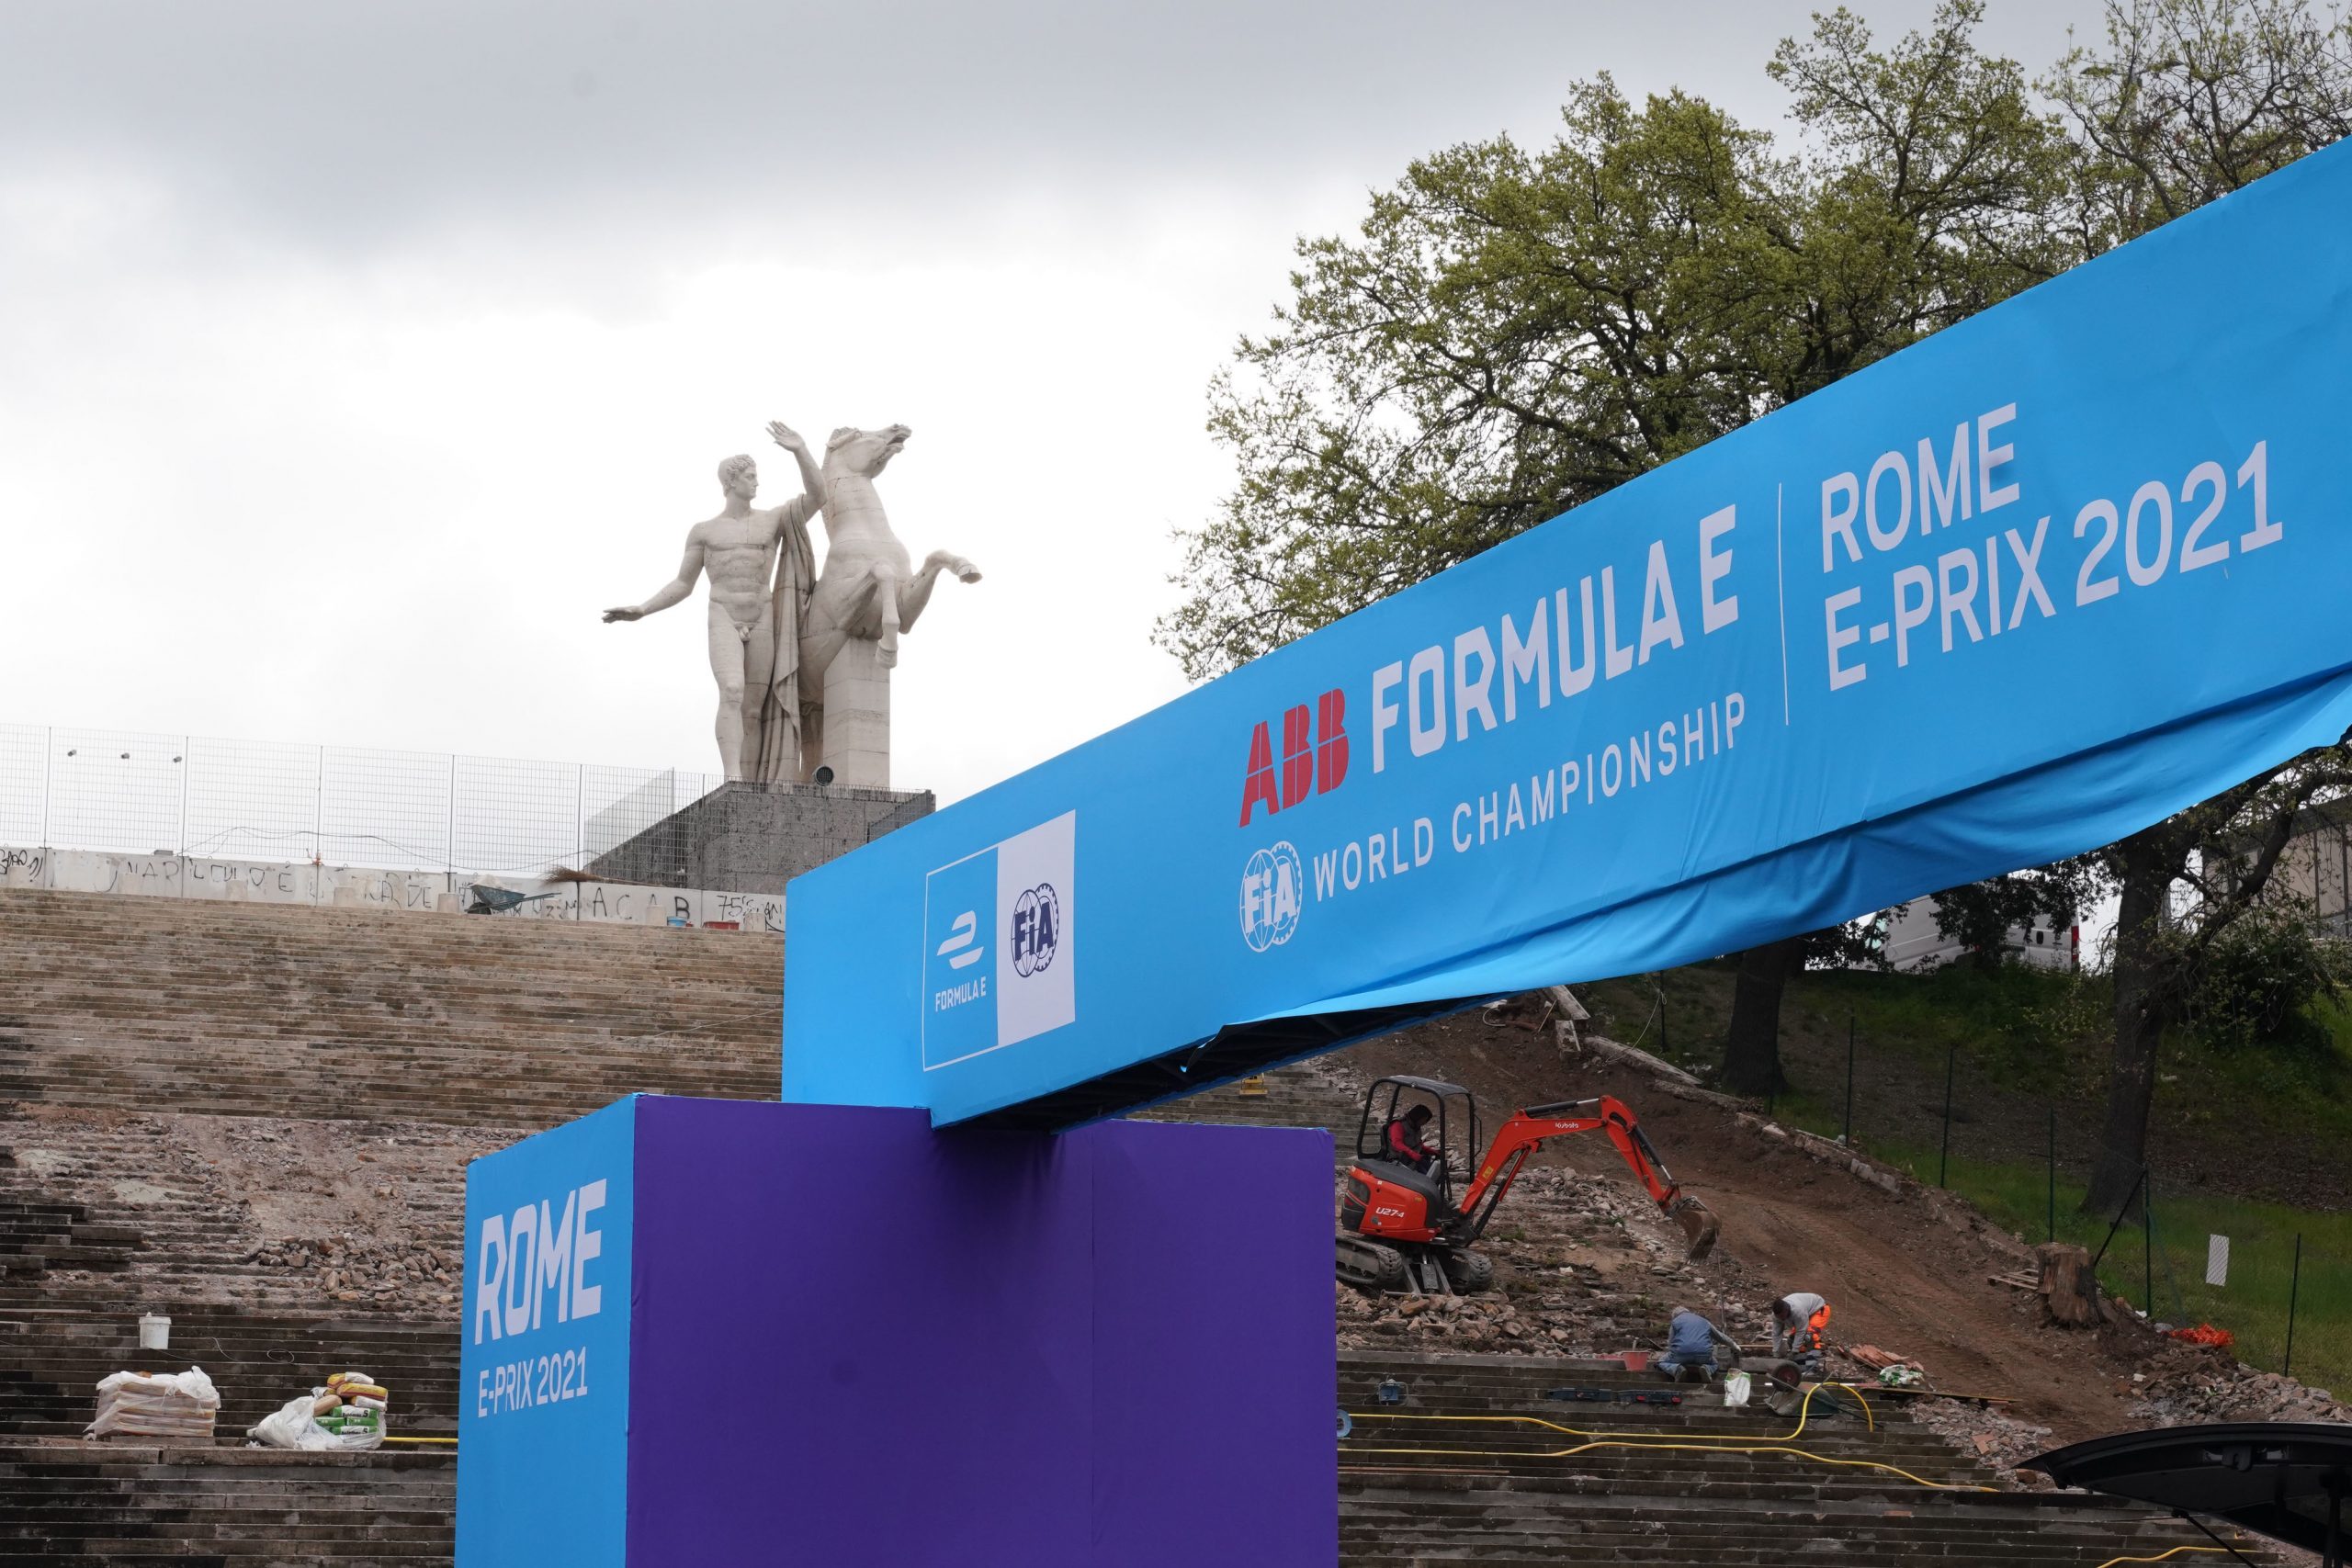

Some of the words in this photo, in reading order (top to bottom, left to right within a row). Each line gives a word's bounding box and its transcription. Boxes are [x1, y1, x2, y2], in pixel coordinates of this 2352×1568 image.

[1821, 402, 2019, 573] ROME
[1825, 516, 2056, 691] E-PRIX
[2074, 440, 2283, 607] 2021
[1239, 688, 1349, 828] ABB
[1372, 540, 1684, 773] FORMULA
[1700, 504, 1738, 635] E
[1314, 818, 1433, 902] WORLD
[1452, 692, 1746, 853] CHAMPIONSHIP
[935, 979, 979, 1011] FORMULA
[980, 976, 987, 997] E
[474, 1179, 606, 1346] ROME
[1375, 1206, 1404, 1218] U27-4
[478, 1359, 534, 1417] E-PRIX
[537, 1346, 588, 1405] 2021
